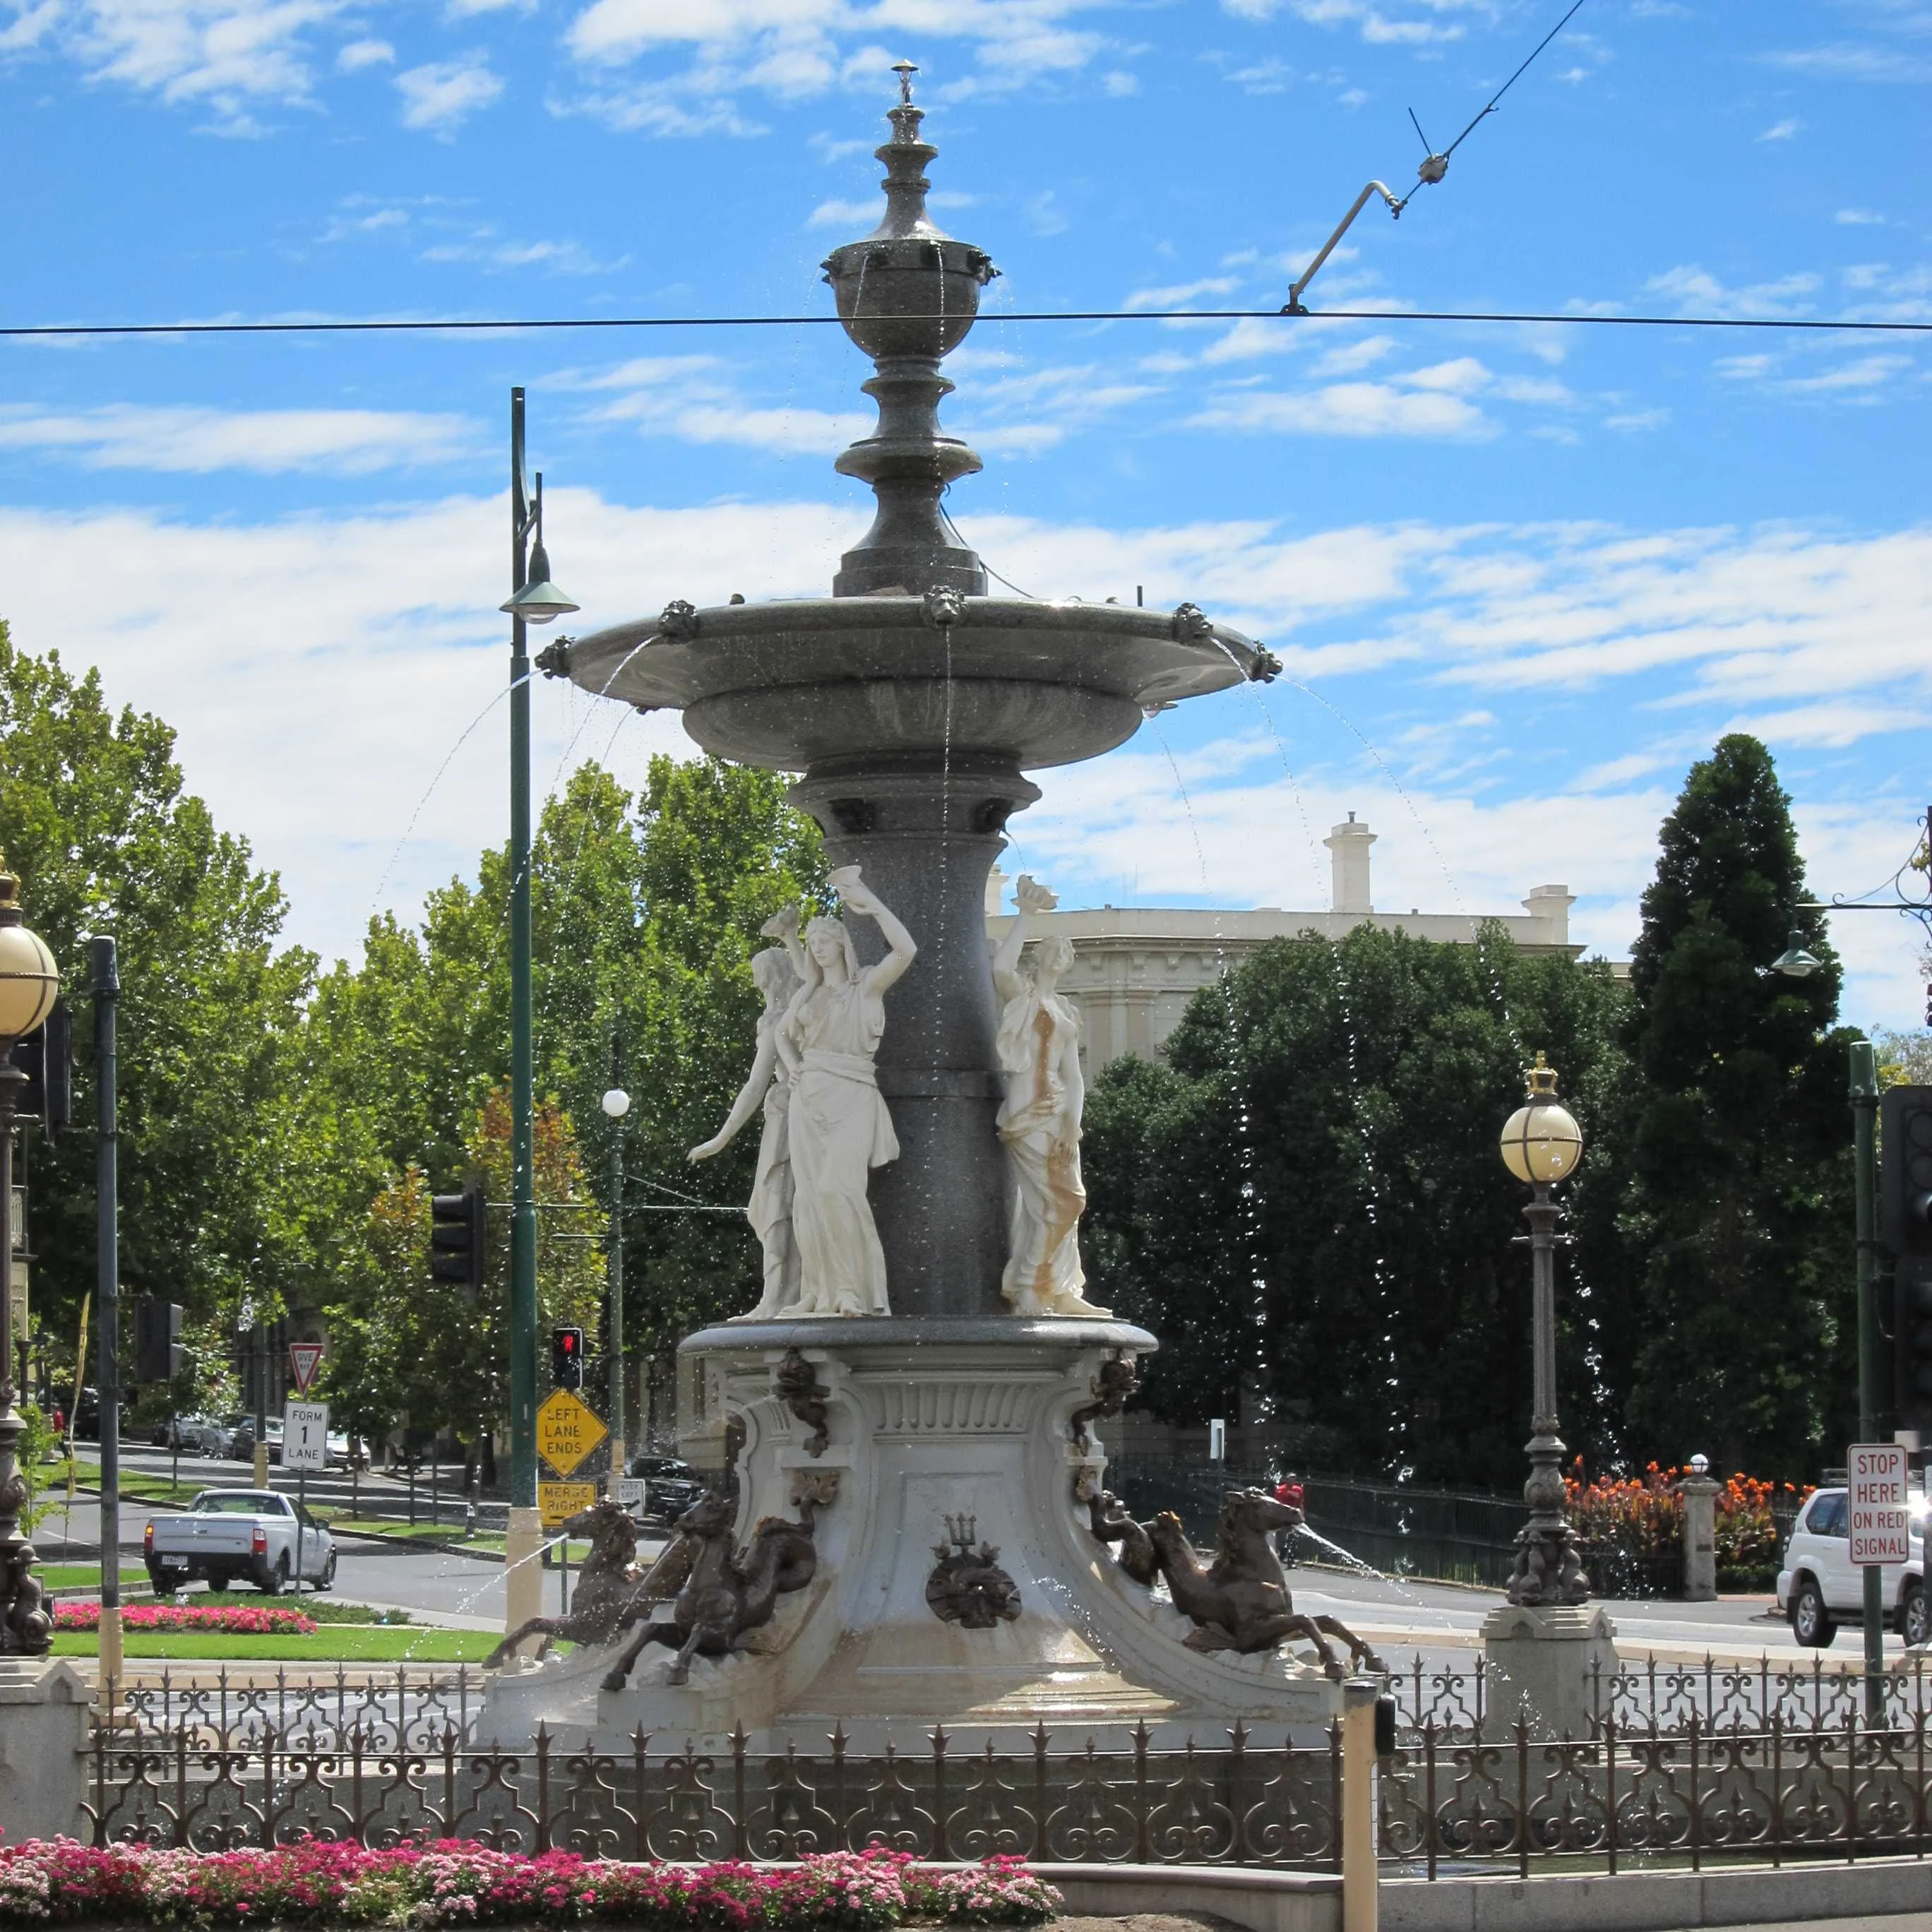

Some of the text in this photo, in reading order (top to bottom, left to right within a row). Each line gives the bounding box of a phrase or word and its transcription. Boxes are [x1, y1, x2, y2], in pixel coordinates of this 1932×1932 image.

[292, 1410, 322, 1422] FORM
[547, 1408, 579, 1421] LEFT
[302, 1426, 307, 1444] 1
[544, 1425, 580, 1438] LANE
[288, 1447, 319, 1460] LANE
[547, 1442, 582, 1454] ENDS
[1858, 1454, 1899, 1474] STOP
[544, 1487, 588, 1498] MERGE
[1857, 1483, 1900, 1503] HERE
[548, 1500, 585, 1510] RIGHT
[1854, 1512, 1904, 1529] ON RED
[1855, 1538, 1906, 1555] SIGNAL
